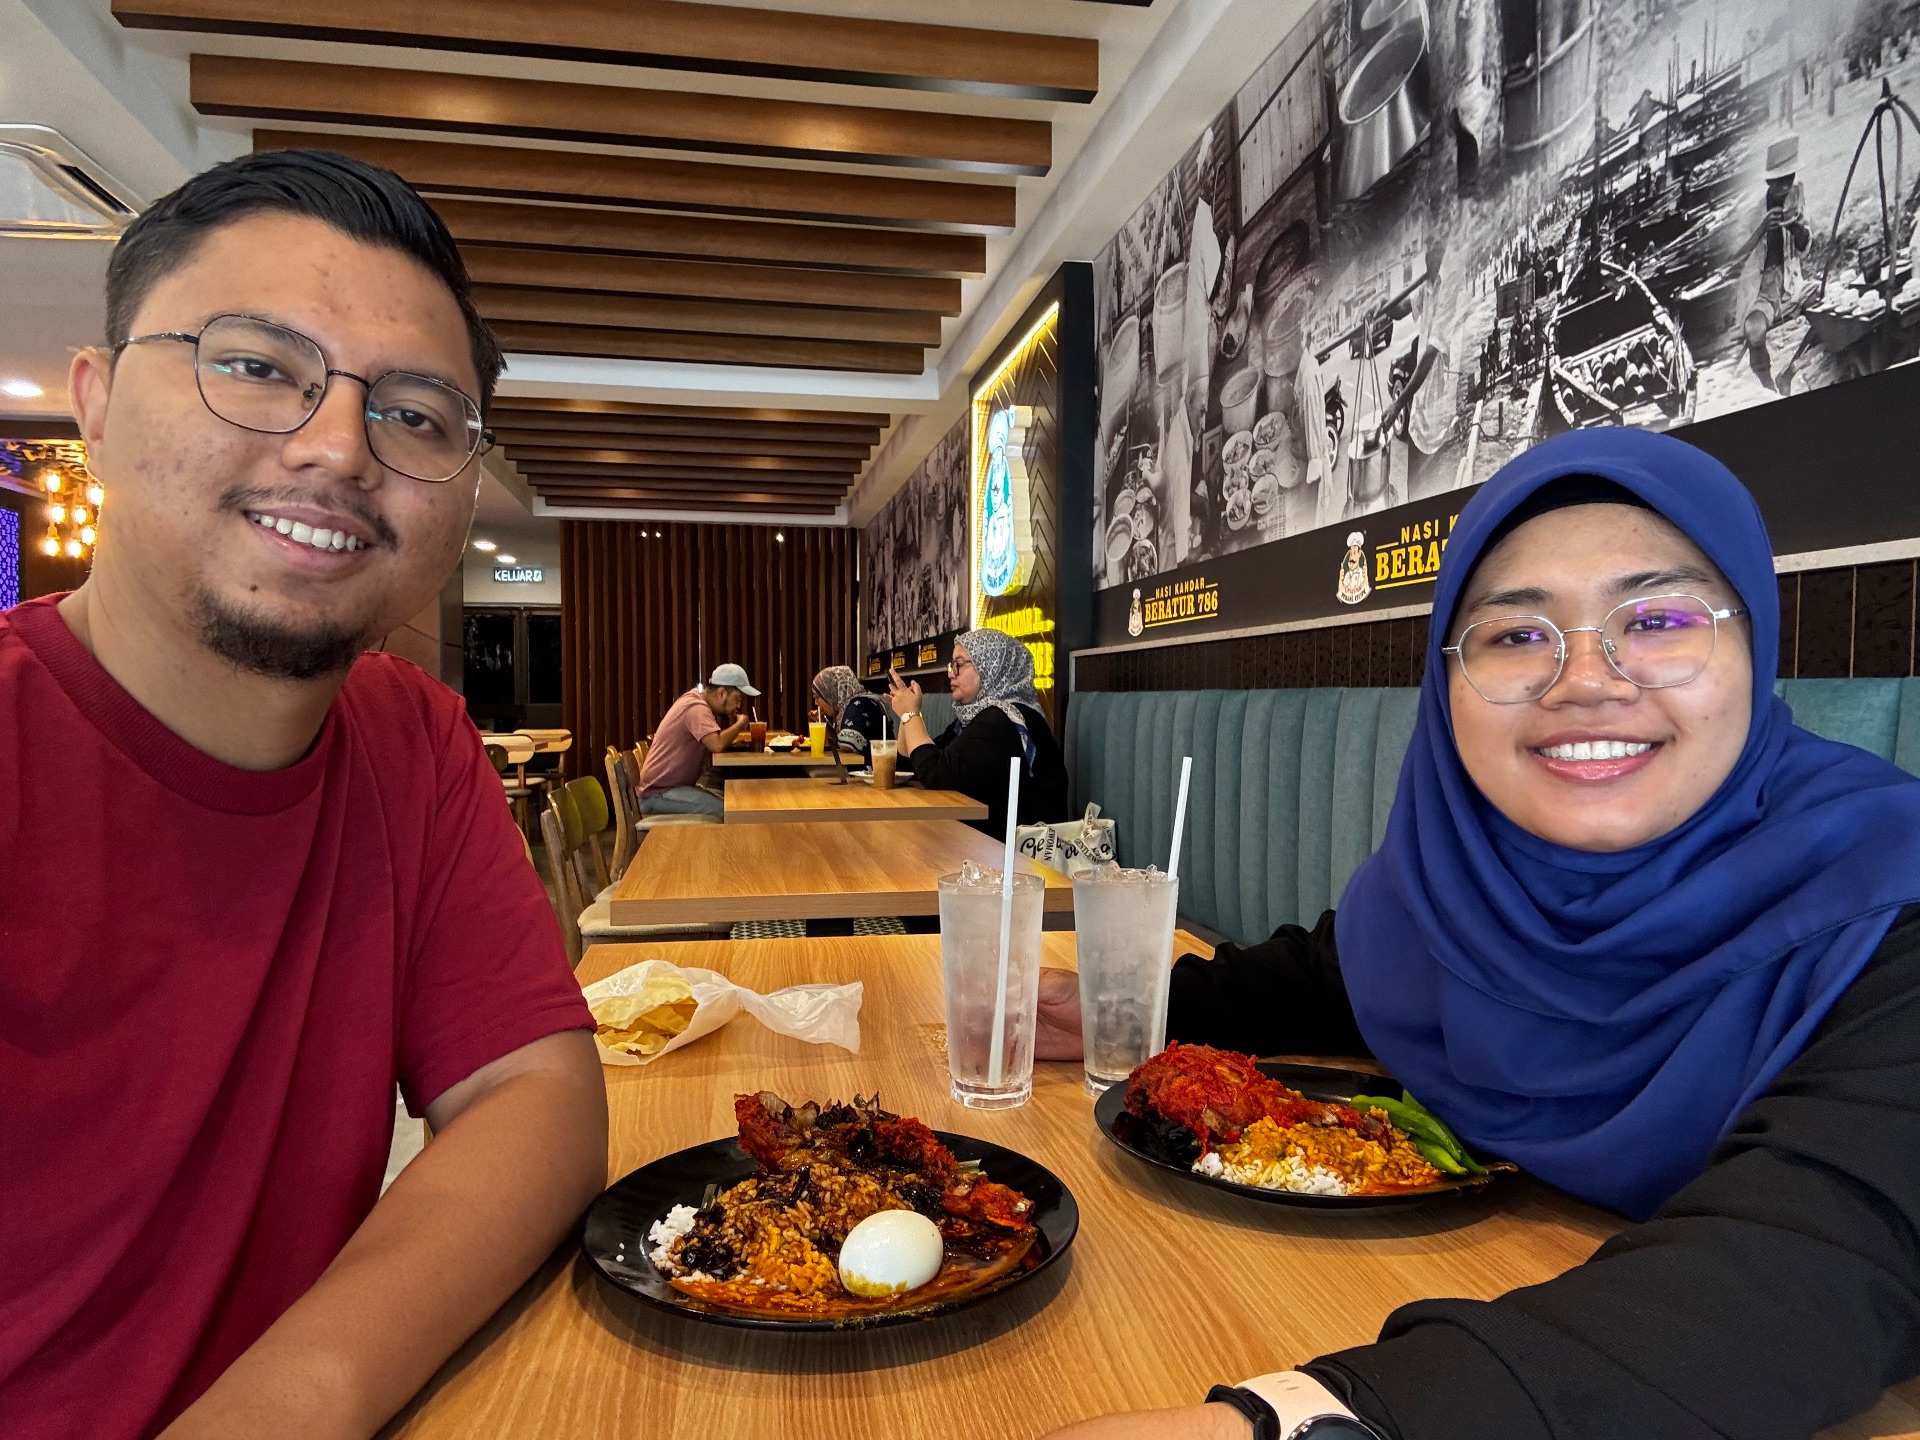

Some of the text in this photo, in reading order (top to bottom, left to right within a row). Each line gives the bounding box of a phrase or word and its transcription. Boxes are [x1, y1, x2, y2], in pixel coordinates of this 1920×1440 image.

[1401, 519, 1439, 544] NASI
[494, 569, 534, 582] KELUAR
[1155, 577, 1205, 600] NASI KANDAR
[1144, 589, 1218, 623] BERATUR 786
